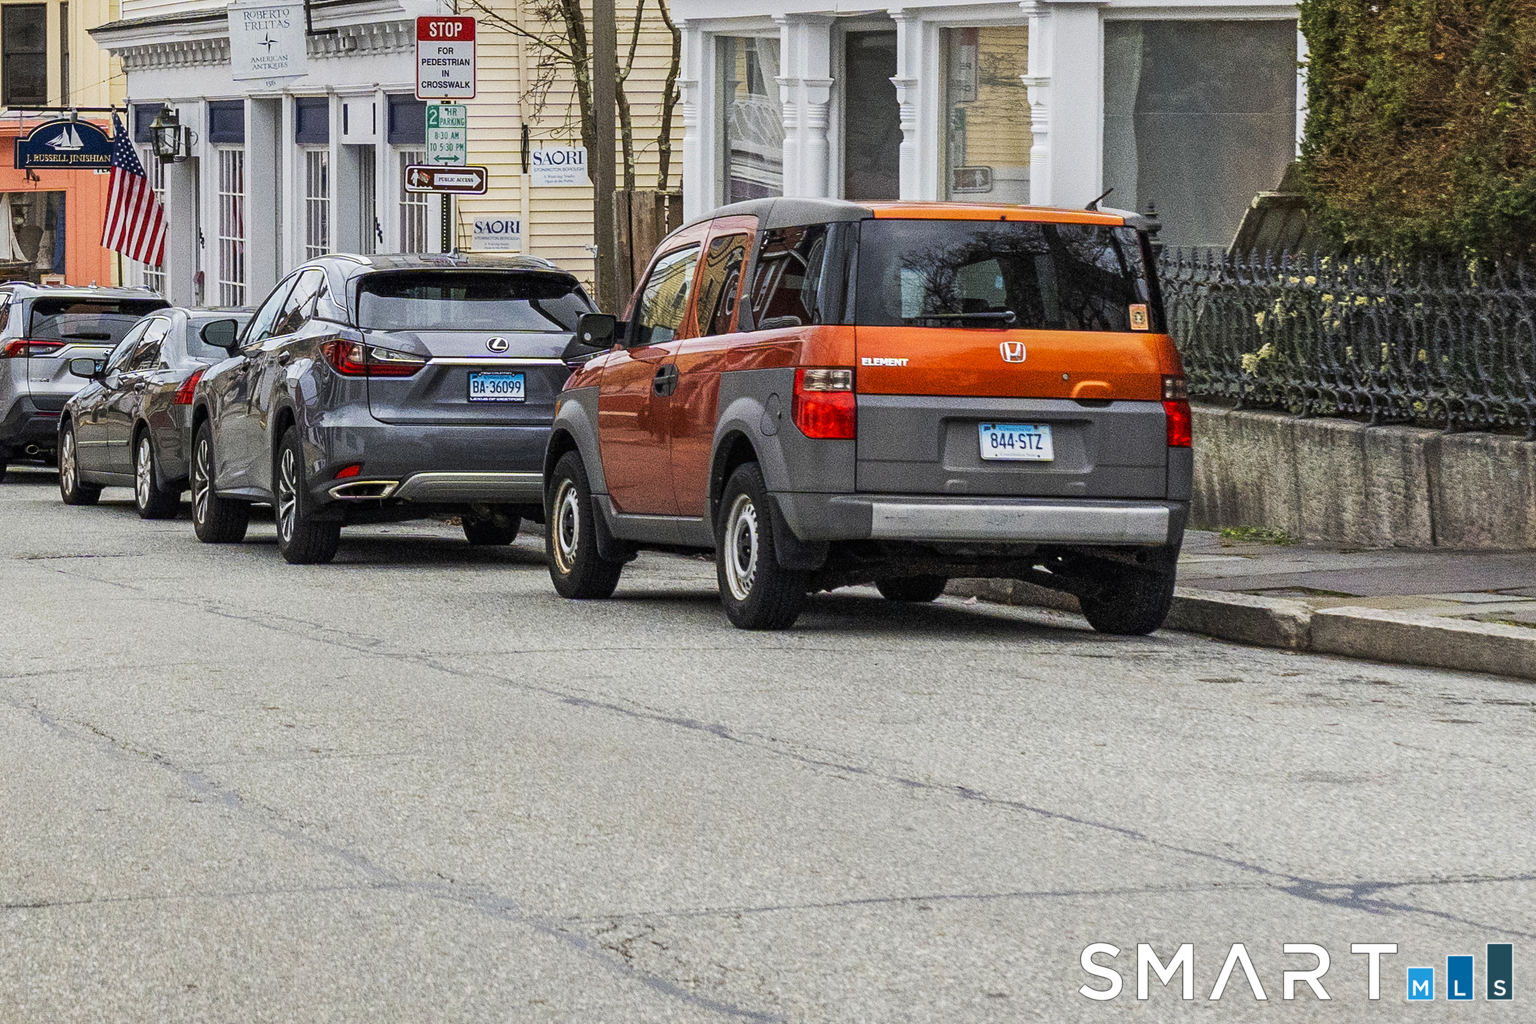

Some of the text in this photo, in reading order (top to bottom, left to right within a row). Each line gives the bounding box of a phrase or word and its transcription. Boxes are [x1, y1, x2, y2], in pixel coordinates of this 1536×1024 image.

[244, 9, 290, 21] ROBERTO
[245, 19, 291, 31] FREITAS
[429, 22, 463, 37] STOP
[251, 55, 288, 63] AMERICAN
[252, 62, 289, 70] ANTIQUES
[429, 108, 457, 125] 2 HR
[440, 118, 465, 126] PARKING
[430, 143, 464, 151] TO 5:30 PM
[25, 154, 111, 164] J. RUSSELL JINISHIAN
[533, 150, 584, 165] SAORI
[474, 220, 521, 234] SAORI
[861, 357, 909, 366] ELEMENT
